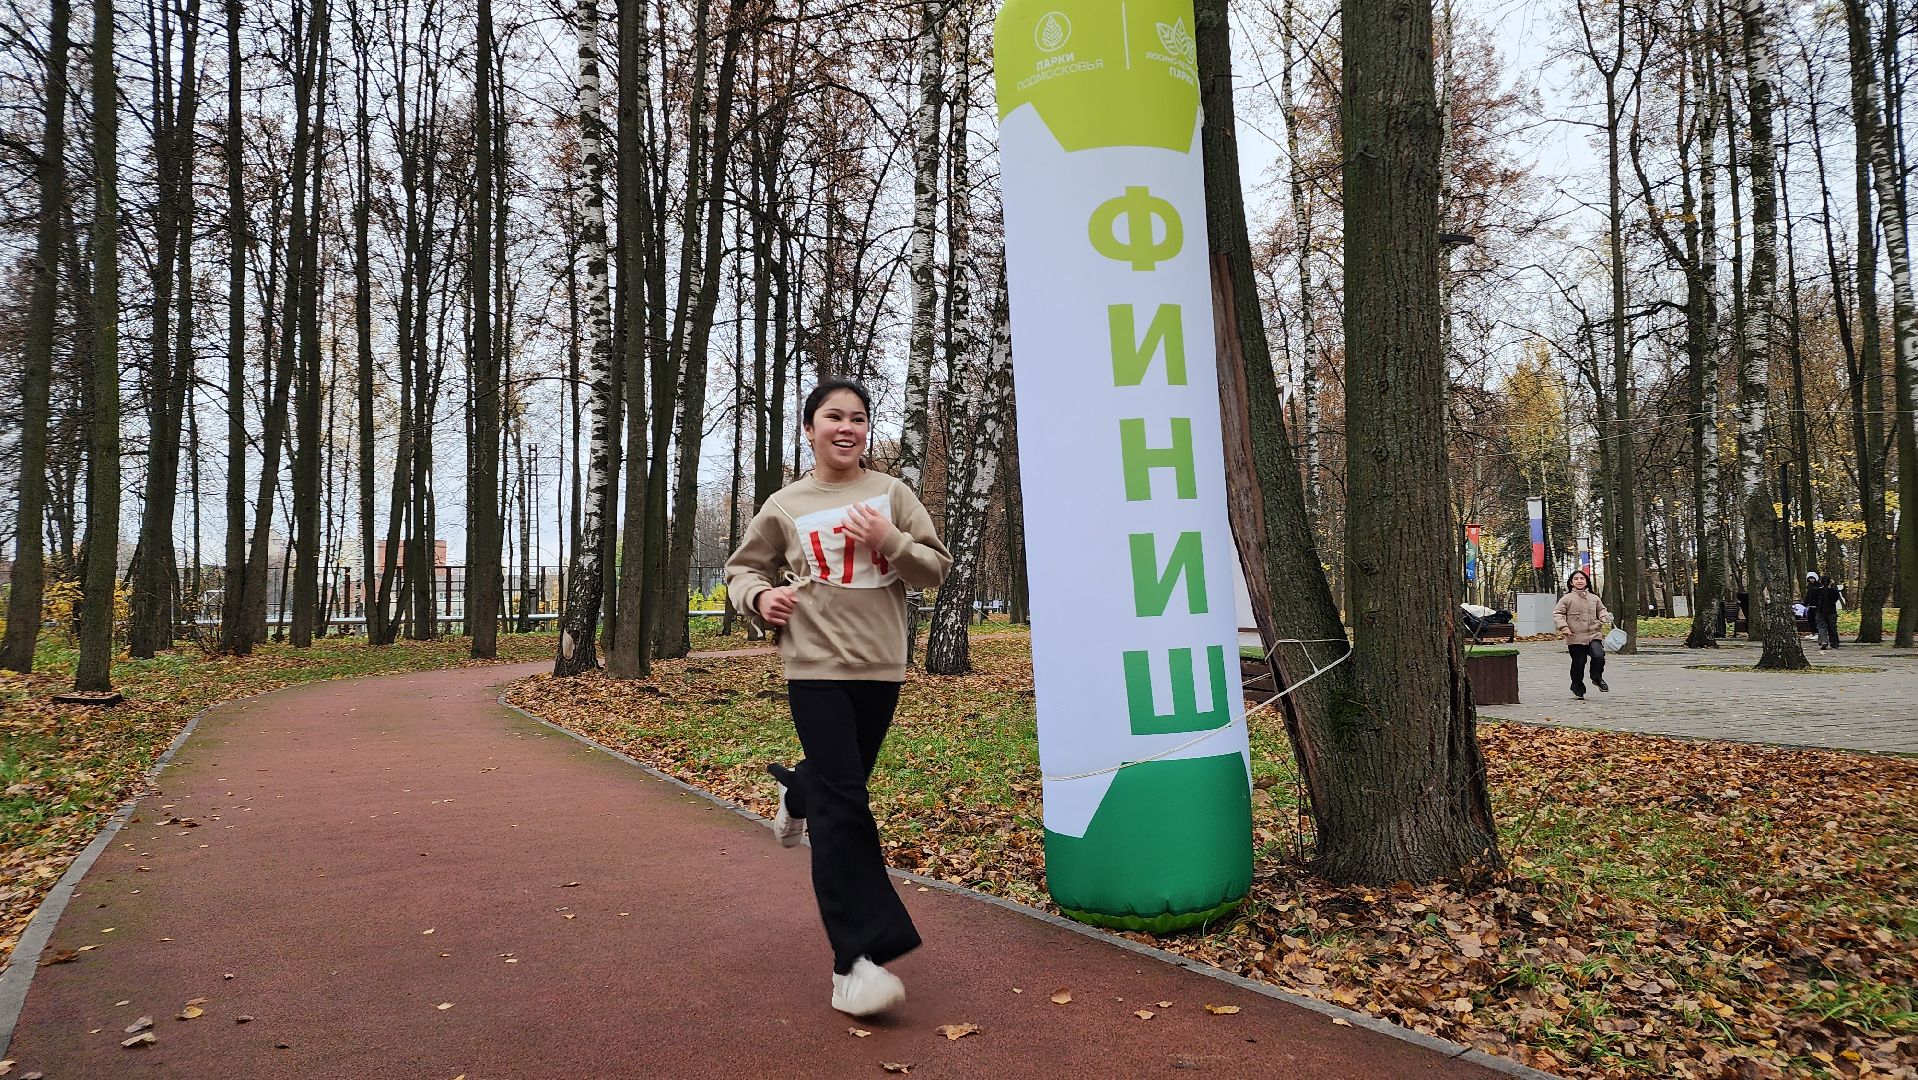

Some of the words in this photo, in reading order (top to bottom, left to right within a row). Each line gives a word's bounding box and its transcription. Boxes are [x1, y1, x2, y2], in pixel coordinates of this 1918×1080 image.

[1017, 58, 1104, 92] ПОДМОСКОВЬЯ
[1036, 52, 1075, 71] ПАРКИ
[1088, 185, 1231, 736] ФИНИШ
